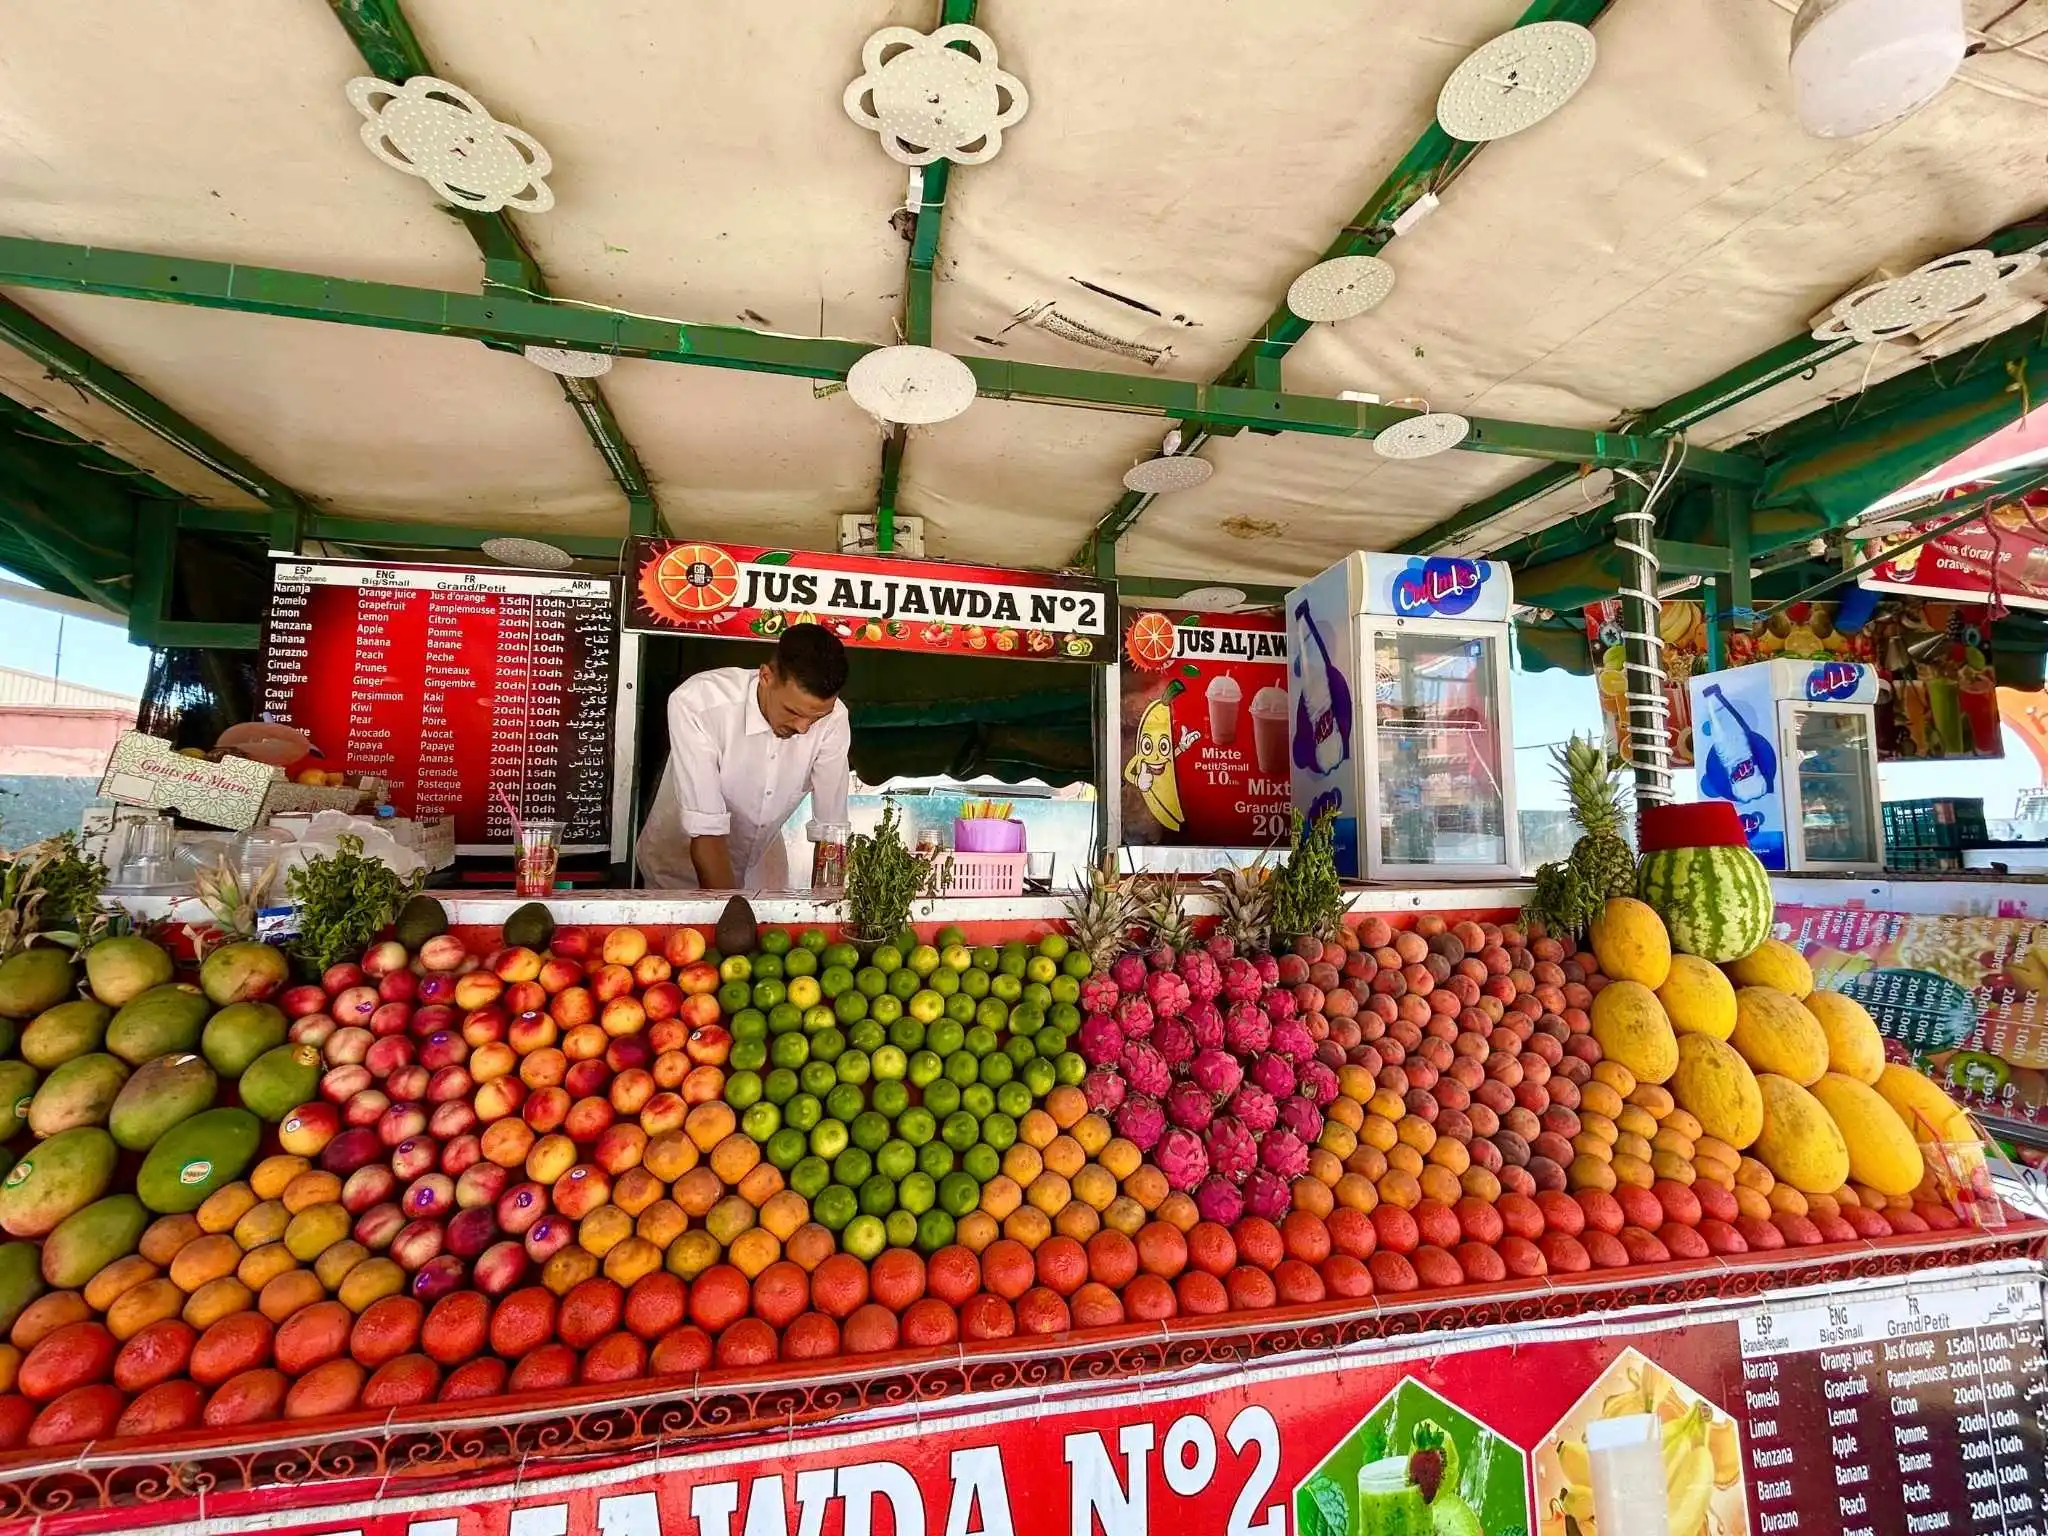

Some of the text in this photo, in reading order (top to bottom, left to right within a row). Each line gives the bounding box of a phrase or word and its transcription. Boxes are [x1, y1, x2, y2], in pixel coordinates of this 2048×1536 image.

[295, 566, 312, 574] ESP
[376, 570, 395, 579] ENG
[362, 578, 410, 586] Big/Small
[465, 575, 476, 583] FR
[274, 583, 311, 594] Naranja
[437, 582, 506, 592] Grand/Petit
[572, 581, 591, 590] ARM
[743, 570, 818, 609] JUS
[358, 588, 416, 600] Orange juice
[430, 591, 486, 603] Jus d'orange
[272, 596, 307, 606] Pomelo
[358, 600, 406, 612] Grapefruit
[499, 596, 566, 608] 15dh 10dh
[271, 608, 300, 617] Limon
[429, 604, 496, 615] Pamplemousse
[500, 608, 566, 618] 20dh 10dh
[358, 612, 388, 622] Lemon
[428, 616, 457, 624] Citron
[270, 620, 312, 631] Manzana
[357, 624, 384, 634] Apple
[498, 619, 566, 630] 20dh 10dh
[428, 628, 463, 638] Pomme
[498, 631, 564, 642] 20dh 10dh
[270, 634, 305, 644] Banana
[356, 637, 390, 647] Banana
[1177, 629, 1214, 656] JUS
[427, 640, 462, 650] Banane
[497, 643, 564, 653] 20dh 10dh
[268, 648, 308, 658] Durazno
[356, 650, 384, 660] Peach
[268, 660, 301, 670] Ciruela
[496, 655, 563, 665] 20dh 10dh
[355, 663, 387, 672] Prunes
[426, 666, 470, 675] Pruneaux
[496, 668, 562, 678] 20dh 10dh
[266, 673, 308, 684] Jengibre
[353, 676, 384, 687] Ginger
[424, 678, 476, 688] Gingembre
[495, 682, 562, 691] 20dh 10dh
[265, 688, 294, 700] Caqui
[352, 691, 403, 701] Persimmon
[424, 692, 444, 702] Kaki
[265, 701, 287, 710] Kiwi
[351, 703, 372, 712] Kiwi
[423, 704, 444, 714] Kiwi
[271, 714, 292, 722] eras
[350, 715, 372, 724] Pear
[422, 716, 446, 726] Poire
[349, 728, 390, 738] Avocado
[421, 730, 453, 739] Avocat
[348, 740, 382, 750] Papaya
[420, 742, 455, 752] Papaye
[347, 752, 394, 764] Pineapple
[419, 754, 454, 764] Ananas
[1202, 748, 1241, 760] Mixte
[418, 768, 458, 777] Grenade
[1195, 762, 1249, 772] Petit/Small
[489, 770, 556, 778] 30dh 15dh
[184, 770, 204, 783] du
[207, 775, 254, 796] Maroc
[416, 792, 462, 802] Nectarine
[416, 804, 445, 814] Fraise
[1880, 976, 1904, 1036] 20dh 10dh
[1914, 980, 1939, 1042] 20dh 10dh
[1990, 988, 2016, 1056] 20dh 10dh
[2007, 1287, 2024, 1304] ARM
[1908, 1298, 1920, 1316] FR
[1829, 1306, 1848, 1326] ENG
[1756, 1316, 1772, 1336] ESP
[1888, 1314, 1950, 1336] Grand/Petit
[1820, 1324, 1864, 1345] Big/Small
[1884, 1339, 1935, 1360] Jus d'orange
[1946, 1332, 2009, 1356] 15dh 10dh
[1820, 1346, 1874, 1372] Orange juice
[1742, 1357, 1778, 1381] Naranja
[1950, 1356, 2011, 1378] 20dh 10dh
[1887, 1365, 1948, 1390] Pamplemousse
[1824, 1375, 1869, 1401] Grapefruit
[1953, 1380, 2015, 1404] 20dh 10dh
[1746, 1387, 1780, 1410] Pomelo
[1891, 1396, 1918, 1416] Citron
[1828, 1408, 1858, 1427] Lemon
[1957, 1409, 2020, 1434] 20dh 10dh
[1749, 1418, 1777, 1438] Limon
[1894, 1426, 1928, 1446] Pomme
[1832, 1433, 1858, 1460] Apple
[1960, 1436, 2024, 1460] 20dh 10dh
[1752, 1447, 1794, 1468] Manzana
[1898, 1452, 1932, 1473] Banane
[1835, 1464, 1869, 1485] Banana
[1966, 1464, 2028, 1490] 20dh 10dh
[1757, 1480, 1792, 1500] Banana
[1902, 1480, 1931, 1504] Peche
[1839, 1492, 1866, 1516] Peach
[1970, 1492, 2032, 1520] 20dh 10dh
[1760, 1510, 1799, 1532] Durazno
[1906, 1511, 1950, 1534] Pruneaux
